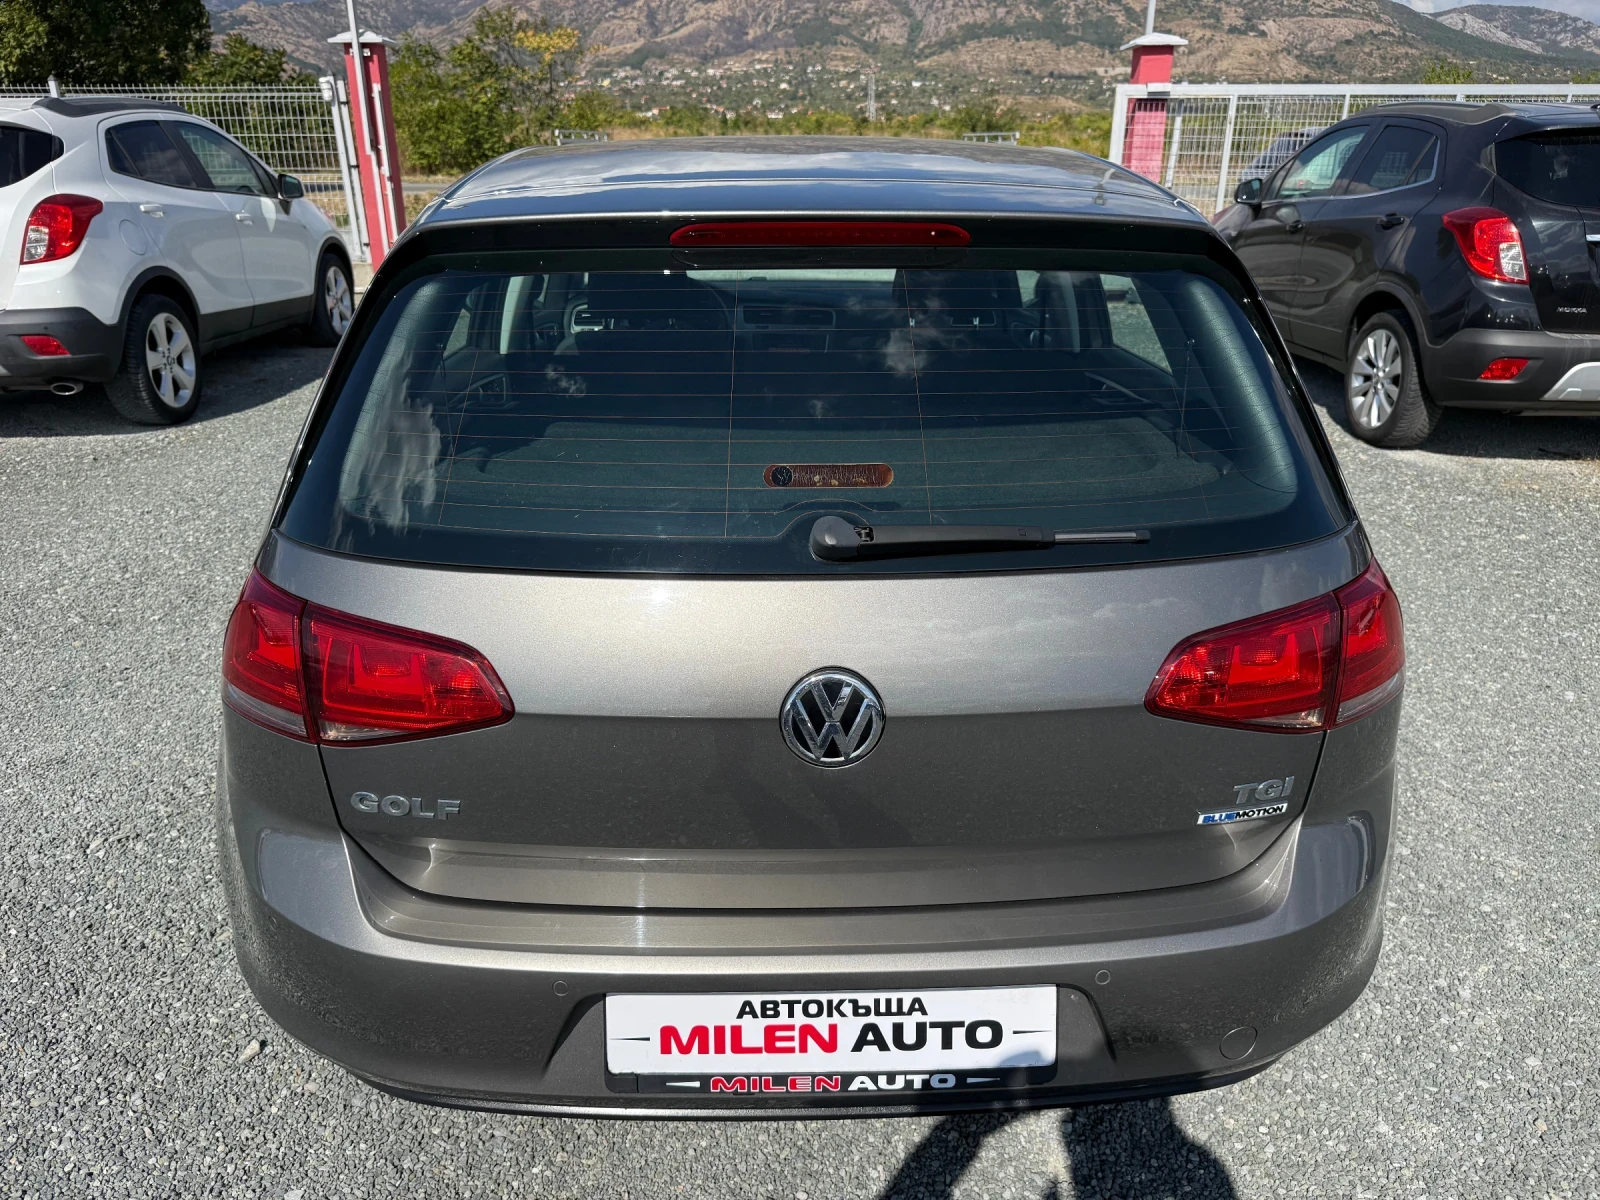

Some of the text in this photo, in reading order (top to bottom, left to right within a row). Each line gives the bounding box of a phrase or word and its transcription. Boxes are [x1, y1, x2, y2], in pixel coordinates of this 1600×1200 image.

[1233, 776, 1295, 804] TGI
[350, 791, 461, 820] GOLF
[1202, 805, 1284, 824] BLUEMOTION
[736, 997, 928, 1019] АВТОКЪЩА
[660, 1019, 1004, 1055] MILEN AUTO
[710, 1073, 956, 1092] MILEN AUTO
